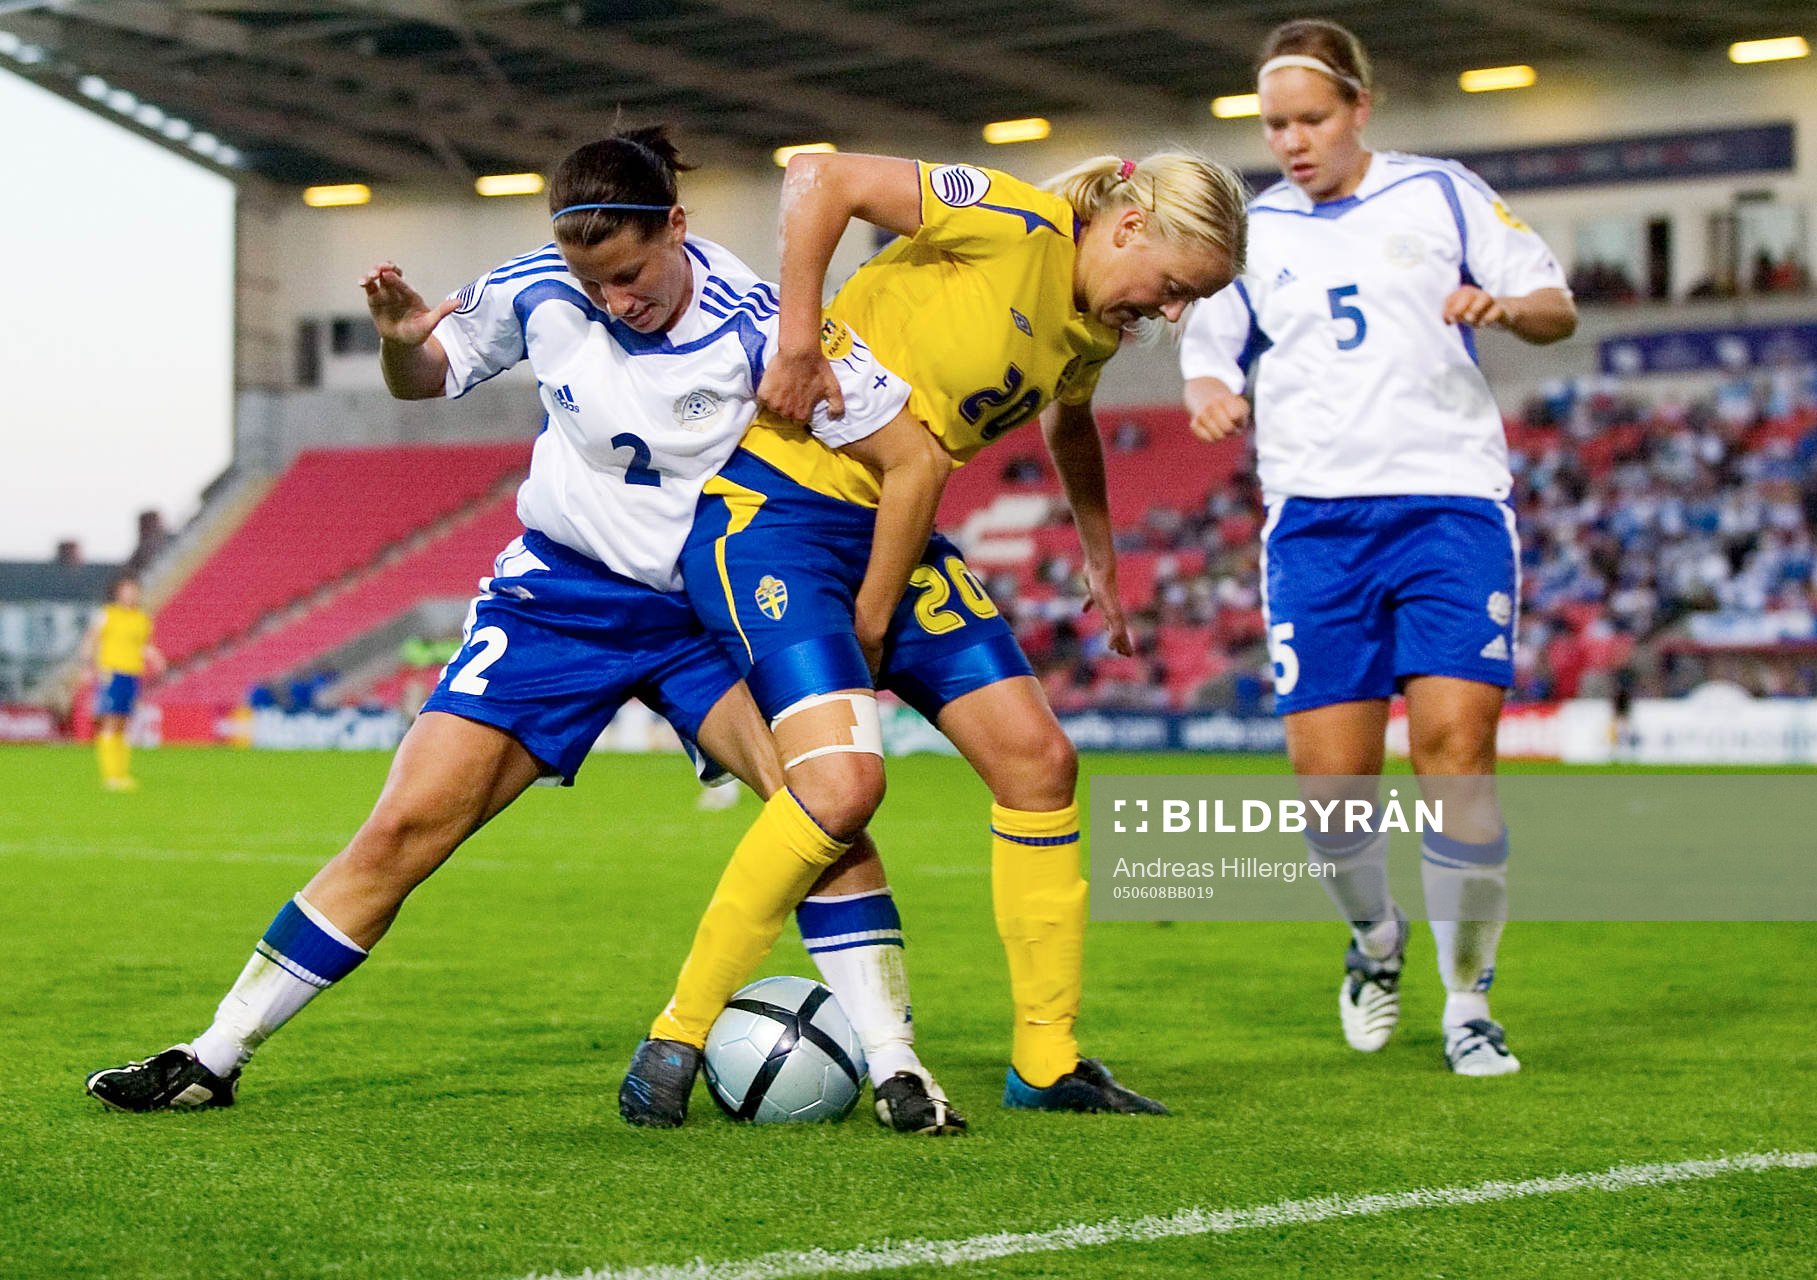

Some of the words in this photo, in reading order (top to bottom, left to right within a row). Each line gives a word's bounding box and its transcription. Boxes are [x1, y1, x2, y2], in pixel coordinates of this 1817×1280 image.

[1327, 284, 1367, 351] 5
[959, 361, 1043, 441] 20
[610, 432, 661, 487] 2
[907, 555, 999, 635] 20
[448, 625, 509, 696] 2
[1270, 621, 1300, 696] 5
